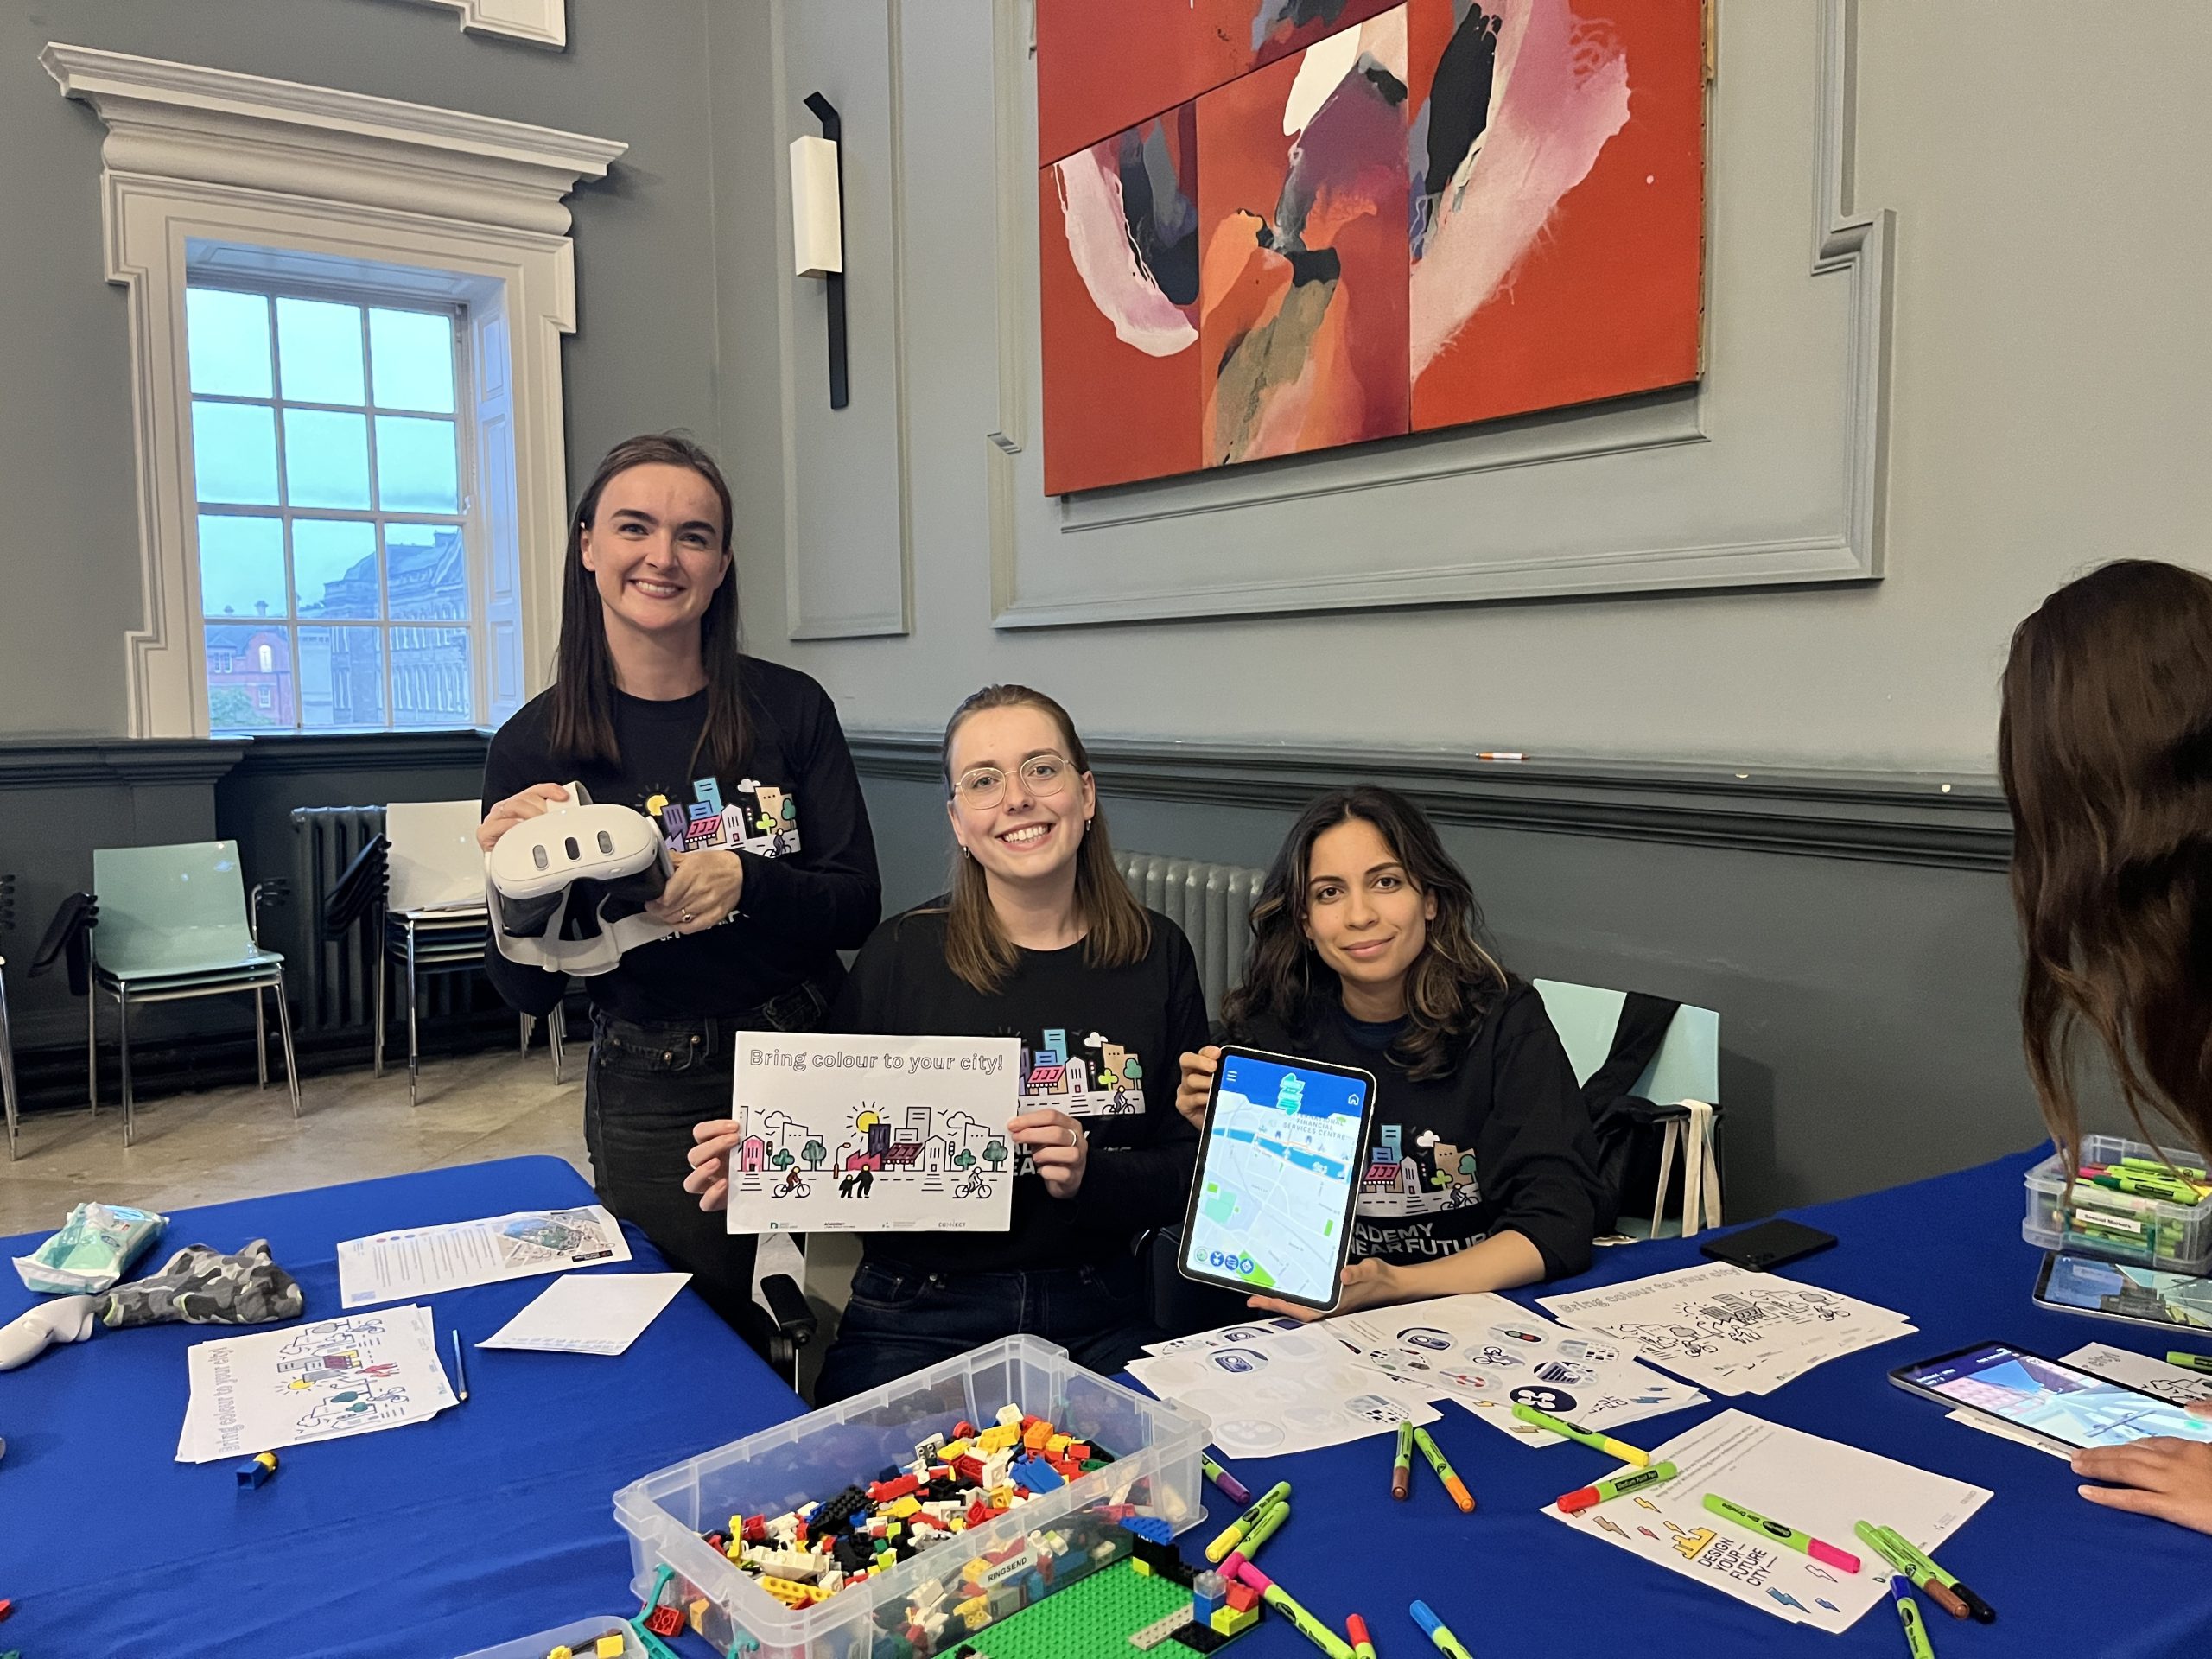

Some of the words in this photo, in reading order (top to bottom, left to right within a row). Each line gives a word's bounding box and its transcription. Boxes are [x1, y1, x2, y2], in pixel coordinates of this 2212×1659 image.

[750, 1049, 807, 1071] Bring
[812, 1052, 878, 1069] colour
[883, 1053, 904, 1069] to
[908, 1054, 956, 1074] your
[960, 1053, 1003, 1075] city!
[1283, 1122, 1316, 1134] SERVICES
[1318, 1130, 1347, 1141] CENTRE
[1296, 1118, 1332, 1131] FINANCIAL
[1355, 1223, 1433, 1243] ADEMY
[1556, 1297, 1610, 1313] Bring
[1605, 1286, 1656, 1302] colour
[1654, 1281, 1676, 1290] to
[1673, 1274, 1709, 1287] your
[207, 1346, 234, 1365] city!
[214, 1366, 238, 1386] your
[213, 1385, 233, 1396] to
[213, 1396, 237, 1426] colour
[215, 1424, 245, 1452] Bring
[1697, 1537, 1735, 1567] DESIGN
[1713, 1549, 1745, 1572] YOUR
[988, 1557, 1027, 1582] RINGSEND
[1729, 1548, 1768, 1580] FUTURE
[1746, 1566, 1771, 1586] CITY
